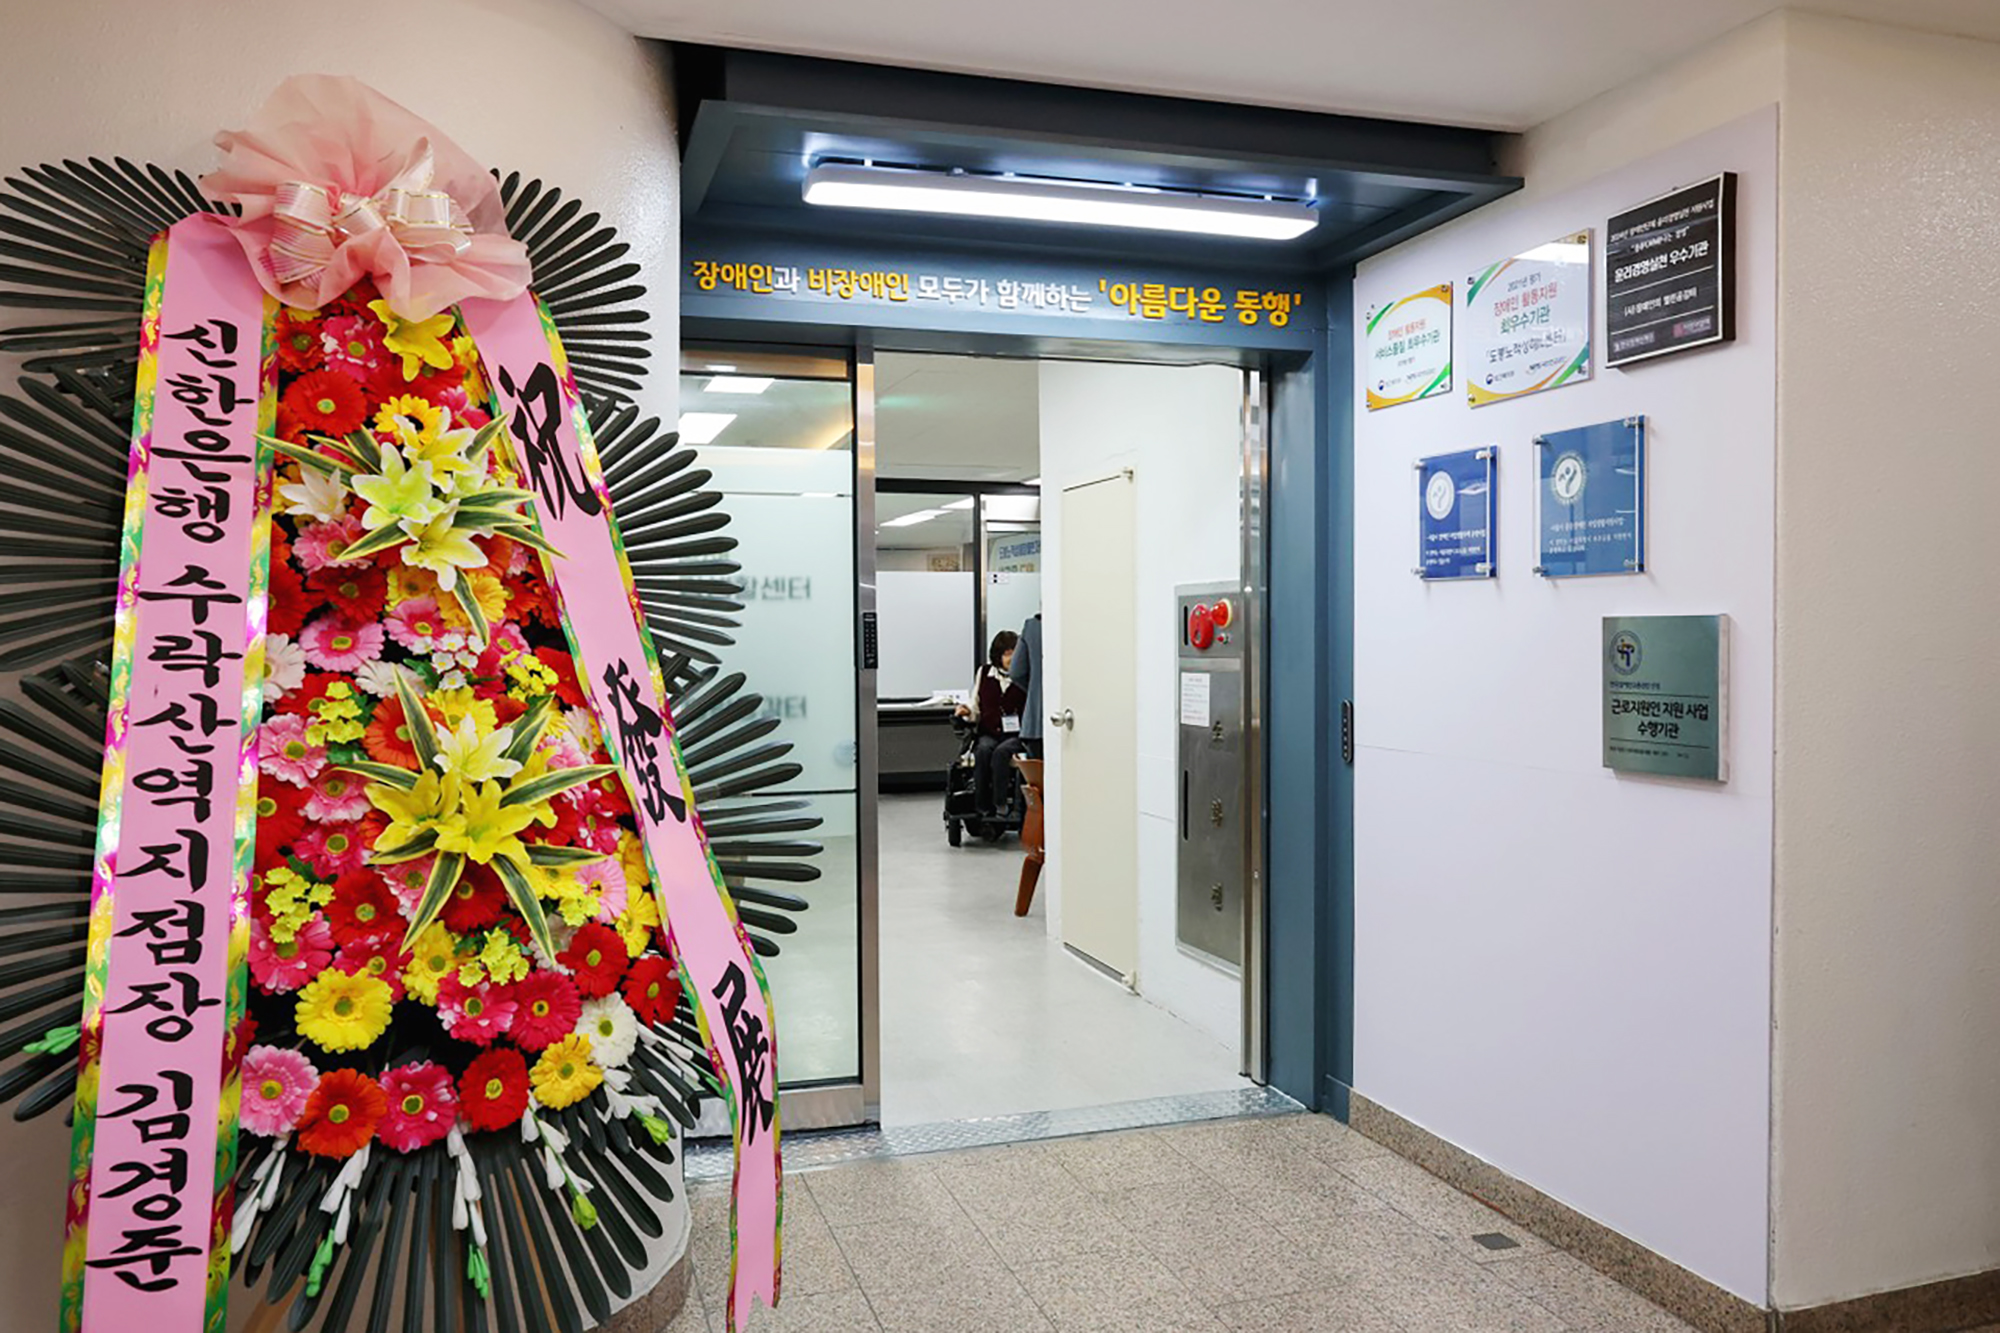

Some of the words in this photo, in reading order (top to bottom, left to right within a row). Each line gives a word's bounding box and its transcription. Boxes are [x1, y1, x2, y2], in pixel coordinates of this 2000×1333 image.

[1614, 253, 1668, 284] 윤리경영실천
[1669, 240, 1709, 265] 우수기관
[692, 261, 801, 293] 장애인과
[808, 267, 909, 301] 비장애인
[916, 275, 990, 305] 모두가
[996, 278, 1093, 312] 함께하는
[1098, 278, 1227, 321] '아름다운
[1233, 289, 1302, 327] 동행'
[1494, 294, 1519, 317] 장애인
[1522, 281, 1558, 307] 활동지원
[1501, 304, 1550, 334] 최우수기관
[149, 319, 255, 544] 신한은행
[1611, 699, 1661, 718] 근로지원인
[1662, 702, 1684, 719] 지원
[1686, 703, 1709, 721] 사업
[1637, 720, 1680, 739] 수행기관
[85, 1070, 203, 1293] 김경준
